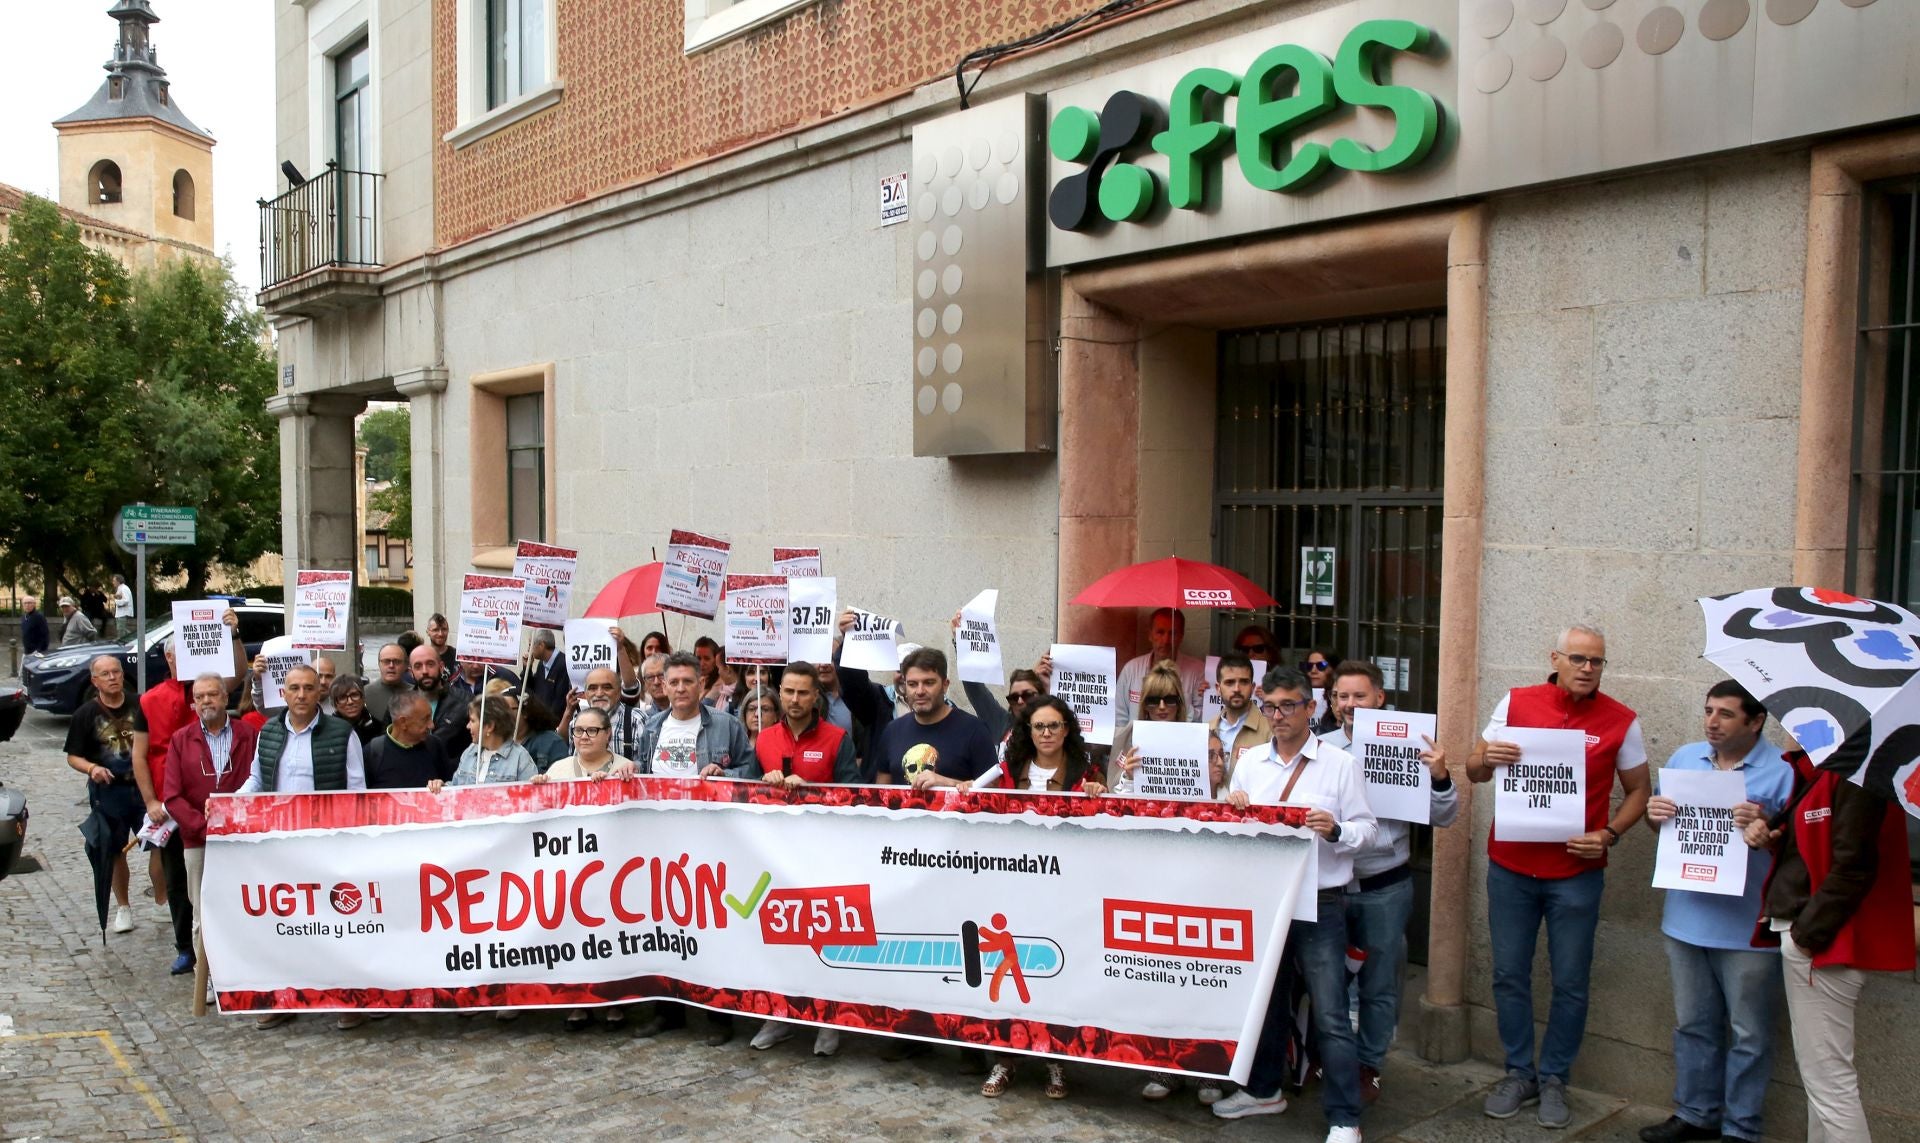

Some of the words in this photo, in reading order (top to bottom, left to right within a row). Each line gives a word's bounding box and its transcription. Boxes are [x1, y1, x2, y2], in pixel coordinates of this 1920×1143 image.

[1152, 19, 1437, 209] fes
[524, 563, 571, 580] REDUCCIÓN
[472, 596, 520, 610] REDUCCIÓN
[736, 596, 784, 608] REDUCCIÓN
[792, 606, 831, 628] 37,5h
[183, 623, 197, 632] MÁS
[200, 623, 222, 632] TIEMPO
[967, 620, 989, 632] TRABAJAR
[184, 632, 200, 640] PARA
[210, 631, 222, 639] QUE
[852, 633, 873, 641] JUSTICIA
[960, 630, 982, 642] MENOS,
[983, 633, 995, 643] VIVIR
[187, 640, 195, 648] DE
[196, 639, 220, 648] VERDAD
[970, 641, 989, 652] MEJOR
[190, 648, 218, 656] IMPORTA
[572, 644, 611, 663] 37,5h
[268, 656, 280, 664] MÁS
[269, 663, 283, 671] PARA
[272, 670, 280, 678] DE
[1059, 672, 1072, 681] LOS
[1074, 672, 1095, 683] NIÑOS
[1098, 675, 1106, 684] DE
[1058, 681, 1076, 692] PAPÁ
[1079, 684, 1108, 695] QUIEREN
[1057, 693, 1070, 701] QUE
[1073, 695, 1108, 705] TRABAJES
[1074, 703, 1091, 714] MÁS
[1365, 744, 1421, 760] TRABAJAR
[1142, 757, 1162, 766] GENTE
[1164, 758, 1176, 766] QUE
[1178, 759, 1187, 767] NO
[1189, 759, 1198, 768] HA
[1364, 757, 1403, 772] MENOS
[1407, 760, 1420, 774] ES
[1142, 766, 1179, 776] TRABAJADO
[1182, 769, 1189, 777] EN
[1191, 769, 1200, 777] SU
[1508, 763, 1573, 779] REDUCCIÓN
[1148, 777, 1162, 785] VIDA
[1164, 777, 1195, 786] VOTANDO
[1364, 770, 1419, 787] PROGRESO
[1141, 785, 1166, 794] CONTRA
[1168, 786, 1180, 795] LAS
[1182, 787, 1204, 796] 37,5h
[1504, 779, 1518, 792] DE
[1522, 780, 1577, 794] JORNADA
[1528, 795, 1551, 808] ¡YA!
[1676, 804, 1696, 817] MÁS
[1698, 807, 1734, 819] TIEMPO
[1675, 818, 1699, 830] PARA
[1702, 820, 1713, 831] LO
[1717, 820, 1734, 832] QUE
[532, 831, 571, 857] Por
[578, 828, 598, 854] la
[1678, 831, 1689, 841] DE
[1693, 832, 1729, 844] VERDAD
[1681, 843, 1724, 856] IMPORTA
[880, 846, 1061, 876] #reducciónjornadaYA
[1688, 867, 1712, 875] CCOO
[241, 883, 321, 917] UGT
[420, 853, 727, 934] REDUCCIÓN
[276, 921, 329, 937] Castilla
[334, 926, 343, 939] y
[348, 919, 384, 935] León
[1113, 909, 1244, 951] CCOO
[446, 943, 482, 972] del
[487, 941, 576, 970] tiempo
[582, 934, 613, 961] de
[618, 926, 698, 962] trabajo
[1104, 953, 1182, 971] comisiones
[1187, 960, 1242, 974] obreras
[1104, 966, 1121, 979] de
[1124, 966, 1176, 985] Castilla
[1179, 976, 1188, 987] y
[1192, 972, 1228, 988] León
